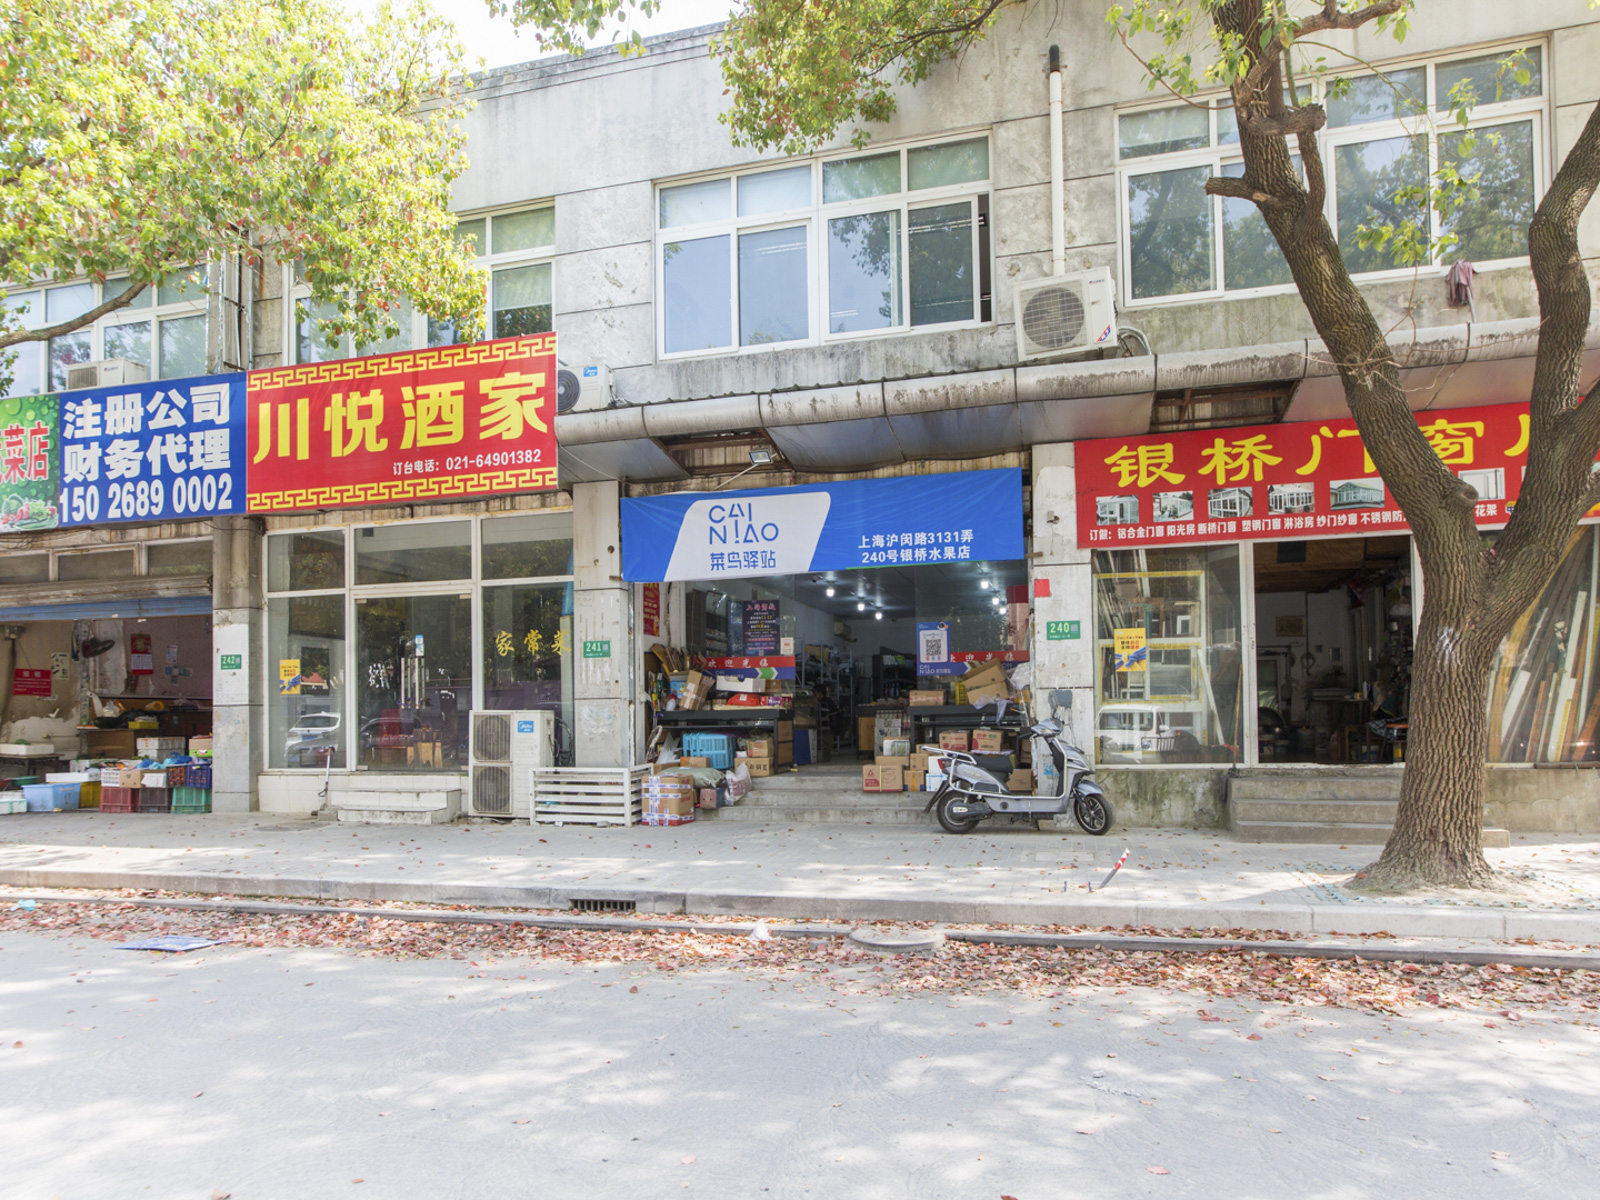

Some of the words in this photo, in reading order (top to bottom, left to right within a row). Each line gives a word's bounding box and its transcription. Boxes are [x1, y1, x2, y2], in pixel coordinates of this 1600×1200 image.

[62, 382, 230, 440] 注册公司
[253, 371, 548, 465] 川悦酒家
[0, 421, 49, 484] 菜店
[62, 428, 231, 484] 财务代理
[1103, 412, 1531, 488] 银桥门窗
[59, 486, 100, 523] 150
[107, 479, 164, 519] 2689
[172, 472, 232, 514] 0002
[708, 502, 753, 525] CAI
[1166, 522, 1196, 537] 阳光房
[1283, 515, 1314, 530] 淋浴房
[1316, 512, 1358, 528] 纱门纱窗
[1360, 510, 1407, 525] 不锈钢防
[1474, 503, 1498, 518] 花架
[857, 528, 974, 550] 上海沪闵路3131弄
[709, 549, 777, 572] 菜鸟驿站
[861, 545, 972, 564] 240号银桥水果店
[1050, 622, 1070, 633] 240
[495, 629, 573, 656] 家常菜
[586, 641, 602, 652] 241
[222, 655, 235, 665] 242
[707, 658, 769, 669] 欢迎光临
